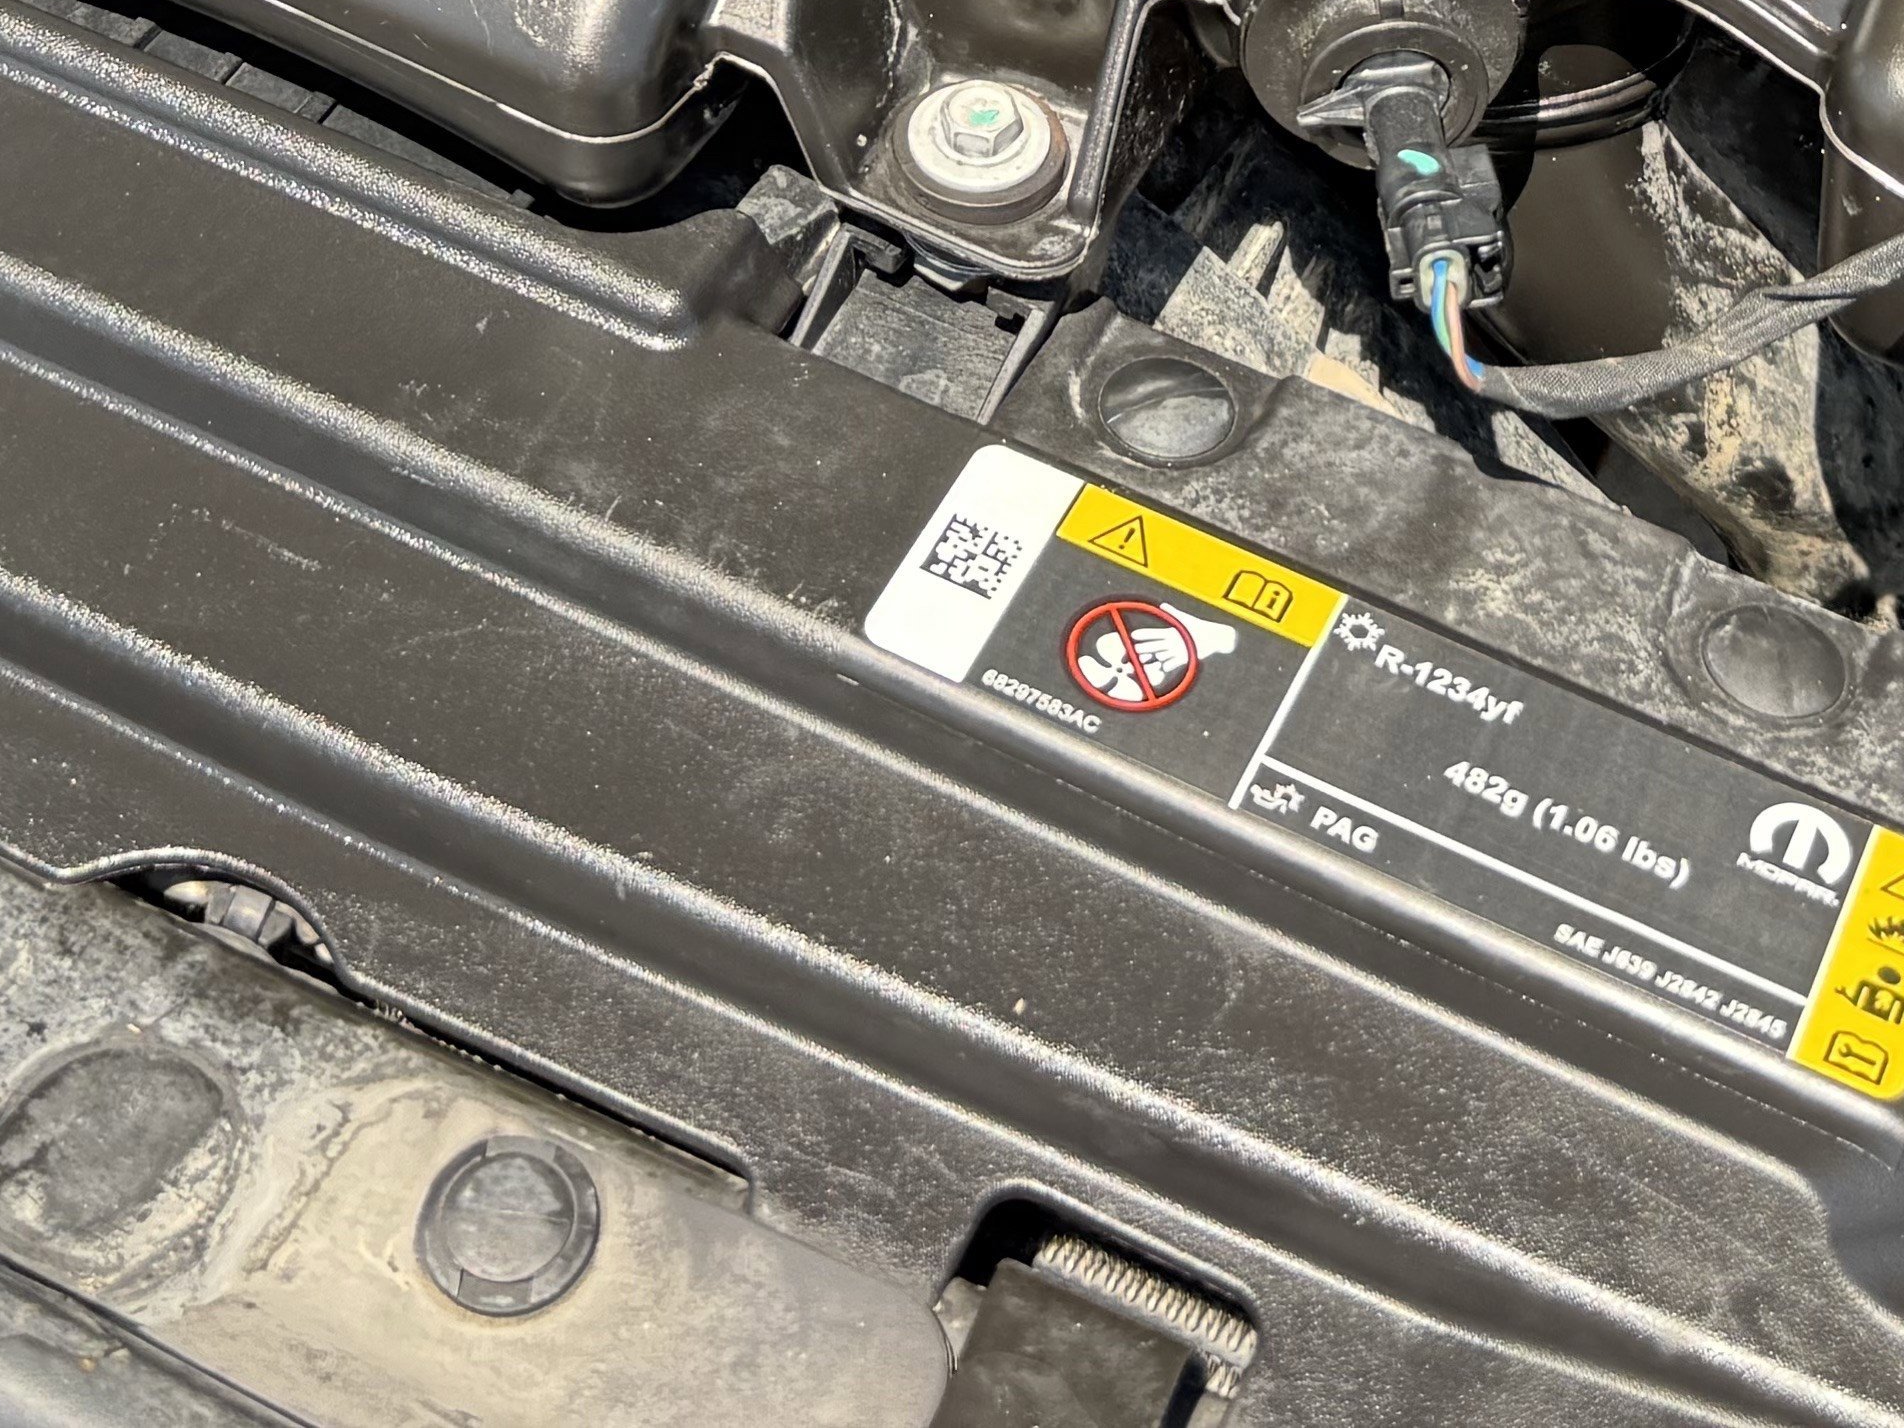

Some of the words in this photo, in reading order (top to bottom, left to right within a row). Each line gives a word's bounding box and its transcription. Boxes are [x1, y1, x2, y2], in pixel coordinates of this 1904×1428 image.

[1376, 644, 1525, 725] R-1234yf
[1311, 802, 1378, 854] PAG
[1443, 760, 1528, 817] 482g
[1533, 796, 1618, 855] (1.06
[1621, 831, 1691, 890] lbs)
[1736, 852, 1837, 906] MOPAR
[1552, 922, 1605, 962] SAE
[1602, 944, 1657, 983] J639
